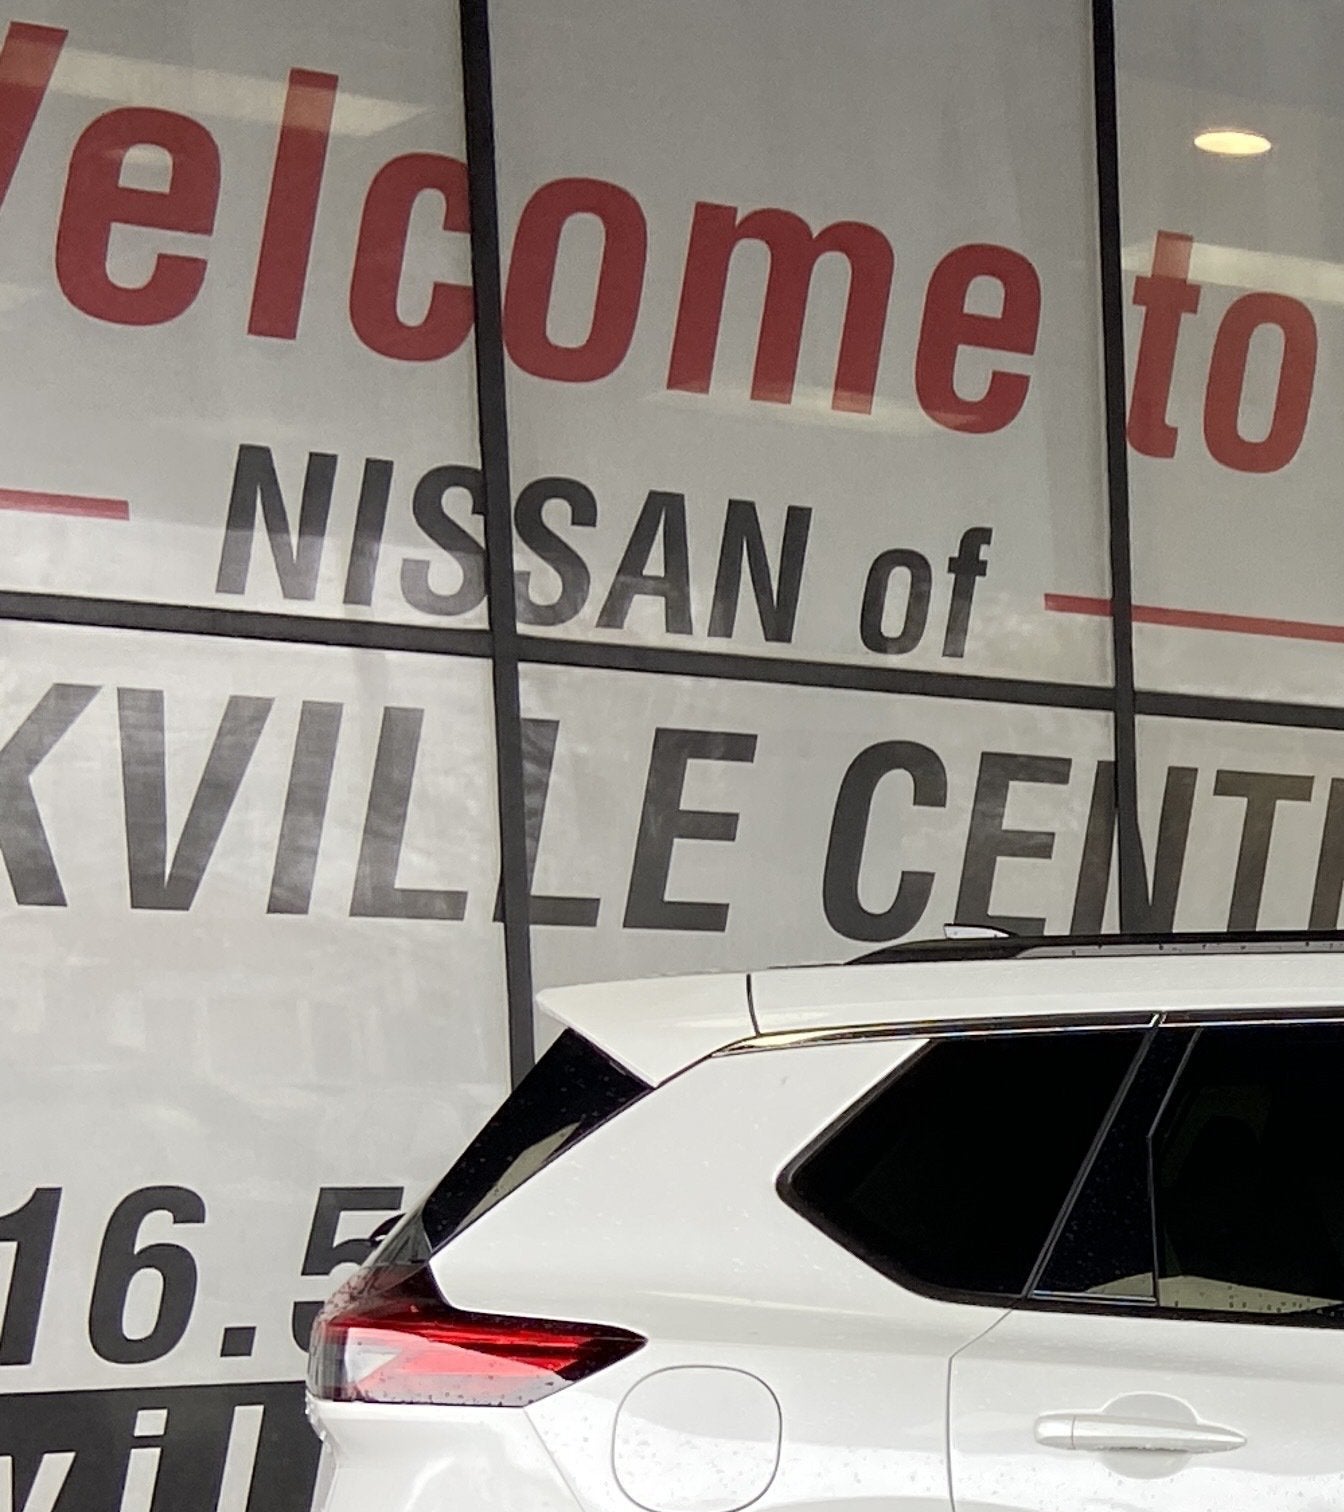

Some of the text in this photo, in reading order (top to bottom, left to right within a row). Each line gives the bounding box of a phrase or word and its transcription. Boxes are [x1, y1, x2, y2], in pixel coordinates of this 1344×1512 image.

[1126, 230, 1318, 473] to
[216, 444, 993, 658] NISSAN of
